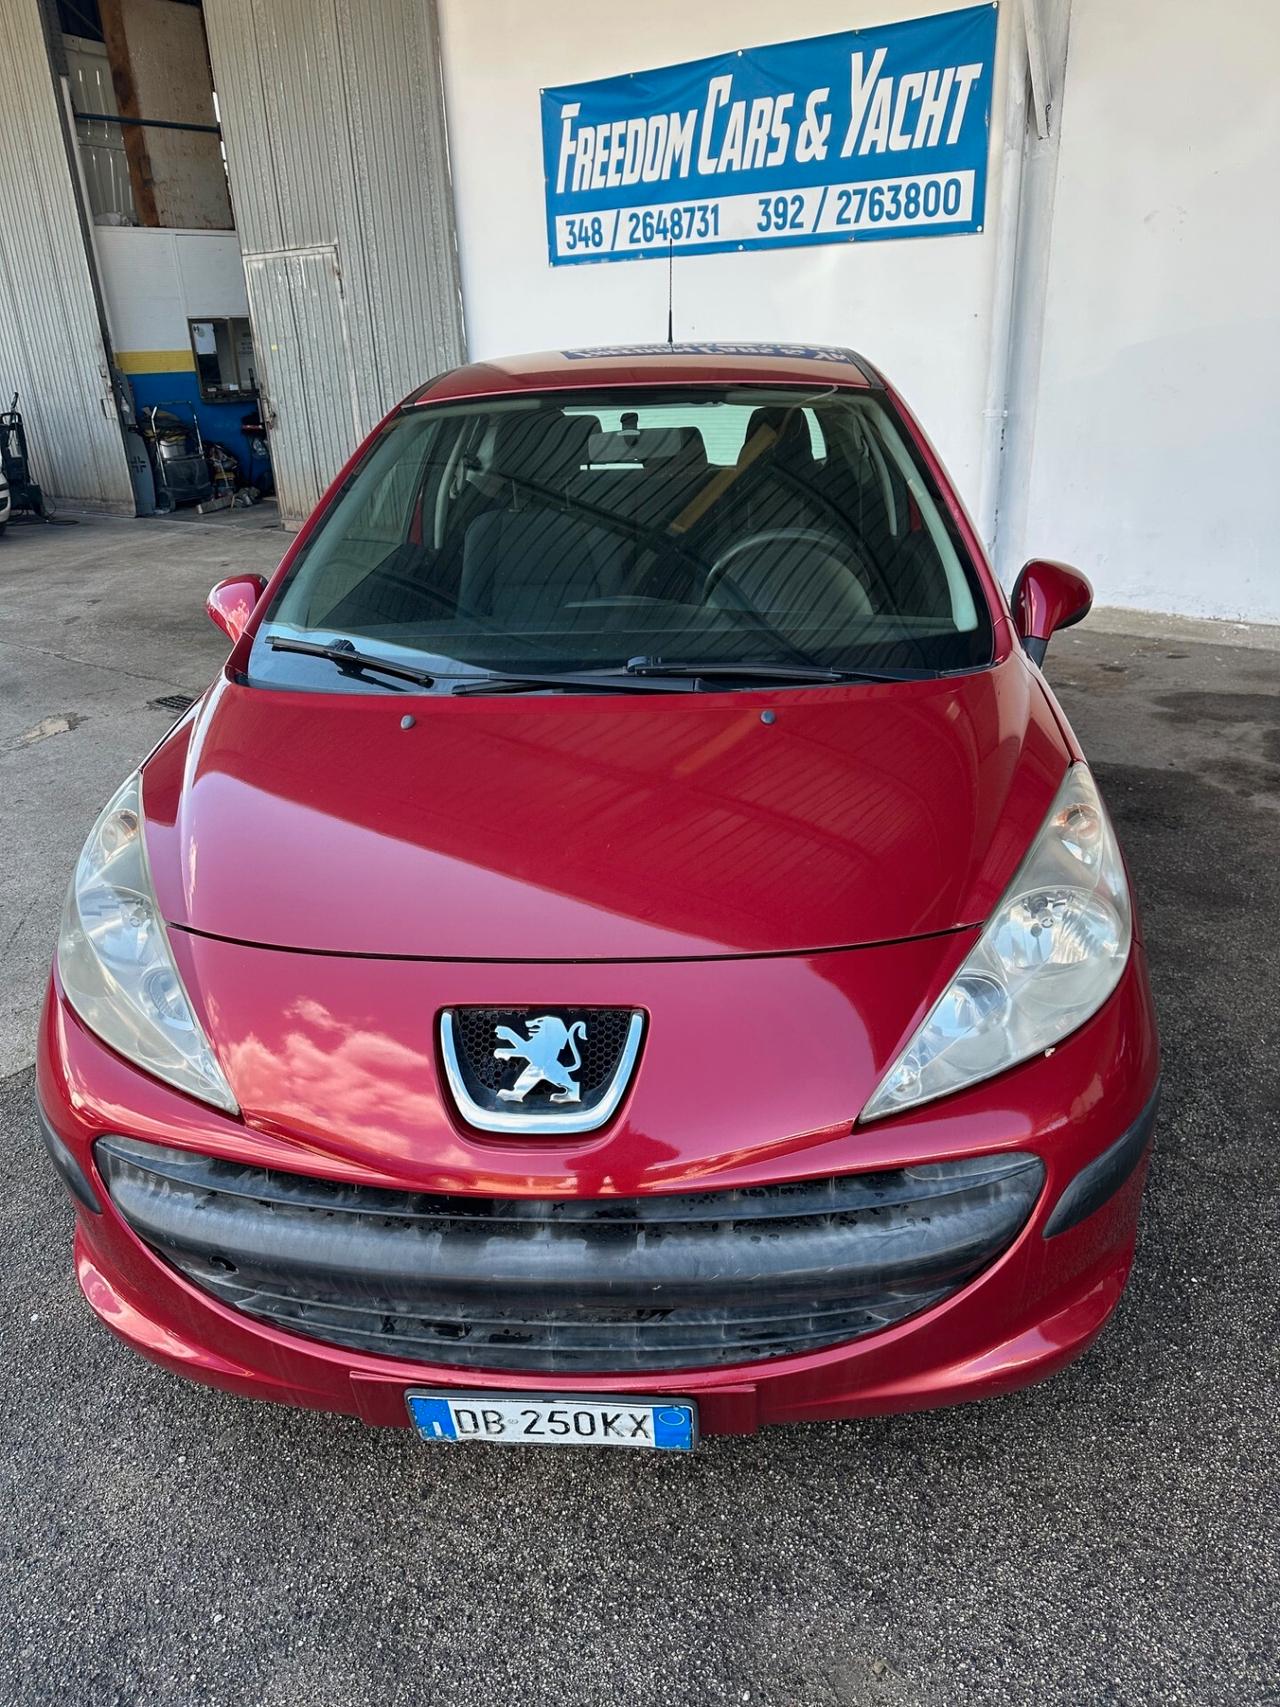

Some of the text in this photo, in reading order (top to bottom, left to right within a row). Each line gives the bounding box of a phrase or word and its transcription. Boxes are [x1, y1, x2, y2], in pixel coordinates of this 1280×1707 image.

[699, 74, 795, 175] CARS
[795, 87, 833, 163] &
[840, 47, 984, 158] YACHT
[565, 178, 962, 251] 348 / 2648731 392 / 2763800
[453, 1409, 652, 1439] DB 250KX
